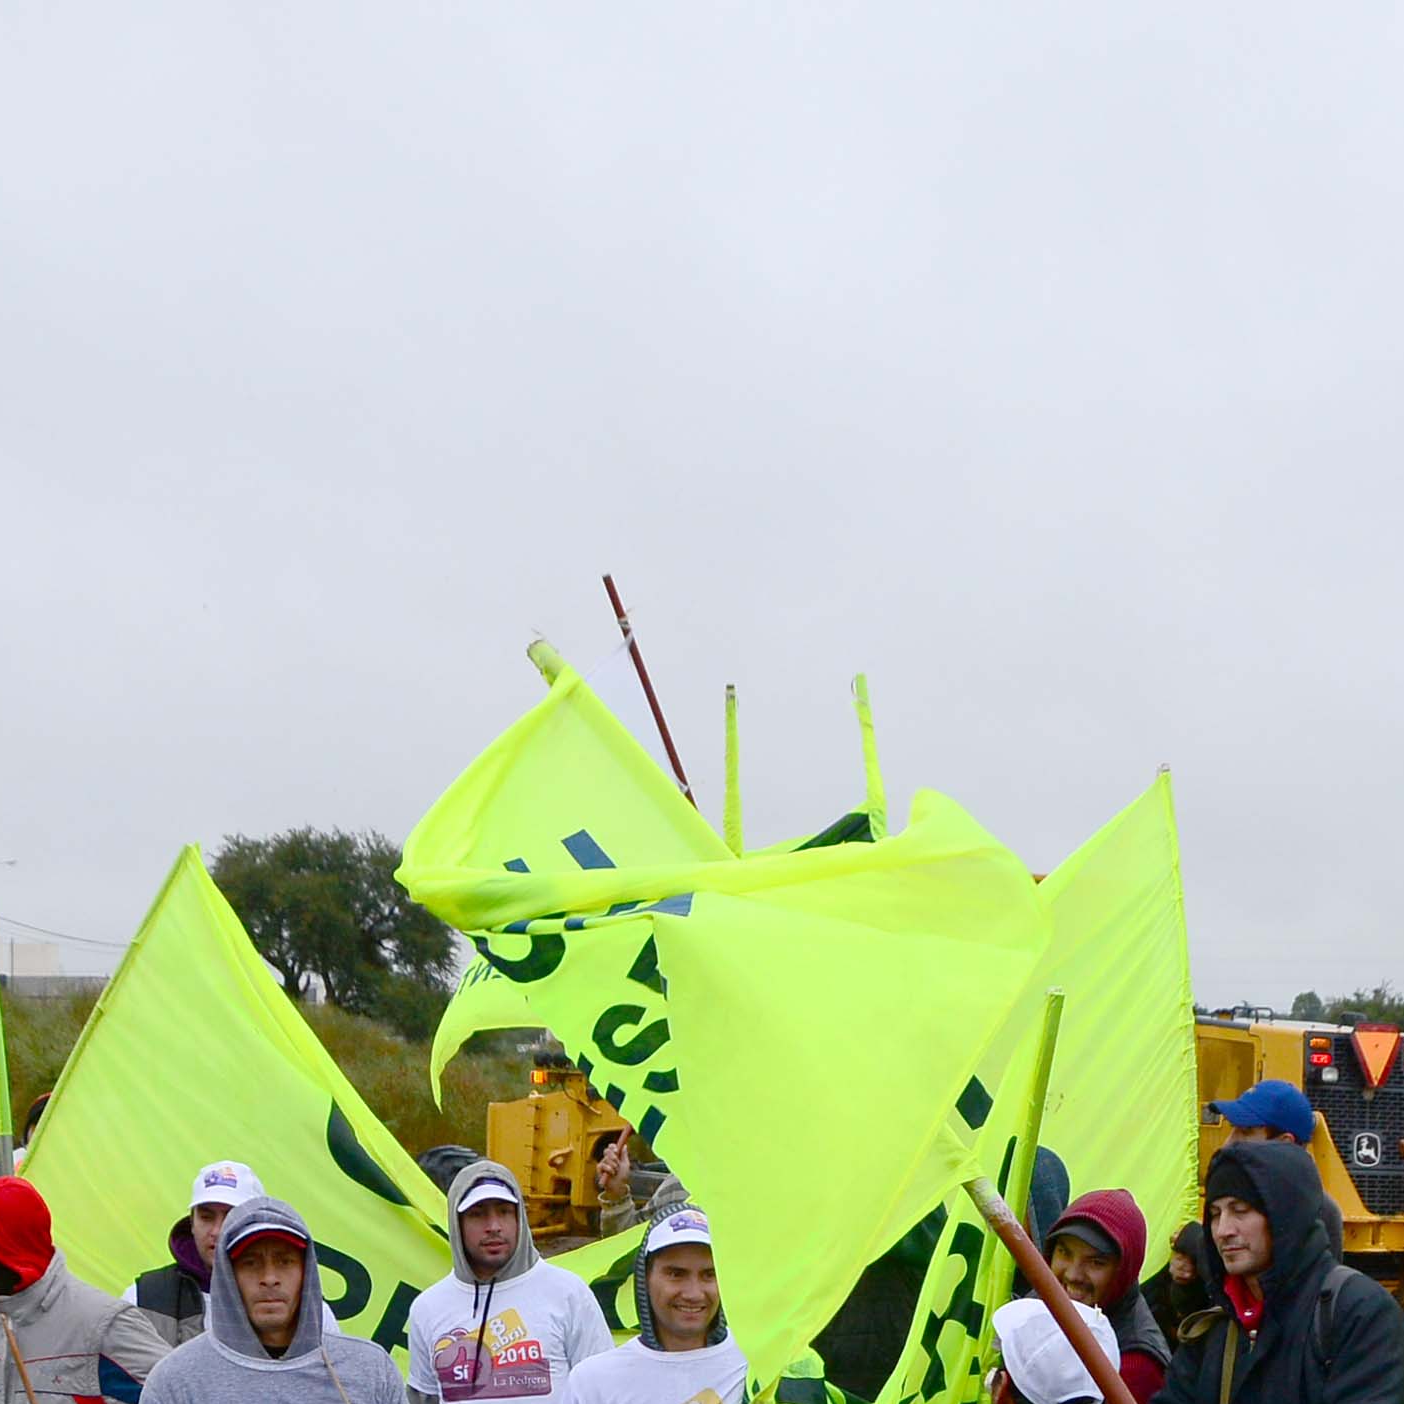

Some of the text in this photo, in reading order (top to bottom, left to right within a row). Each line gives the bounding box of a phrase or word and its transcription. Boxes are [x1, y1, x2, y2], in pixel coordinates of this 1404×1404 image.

[490, 1317, 507, 1337] 8
[491, 1326, 526, 1351] abril
[497, 1345, 539, 1366] 2016
[453, 1364, 469, 1380] Sí
[493, 1375, 547, 1386] La Pedrera
